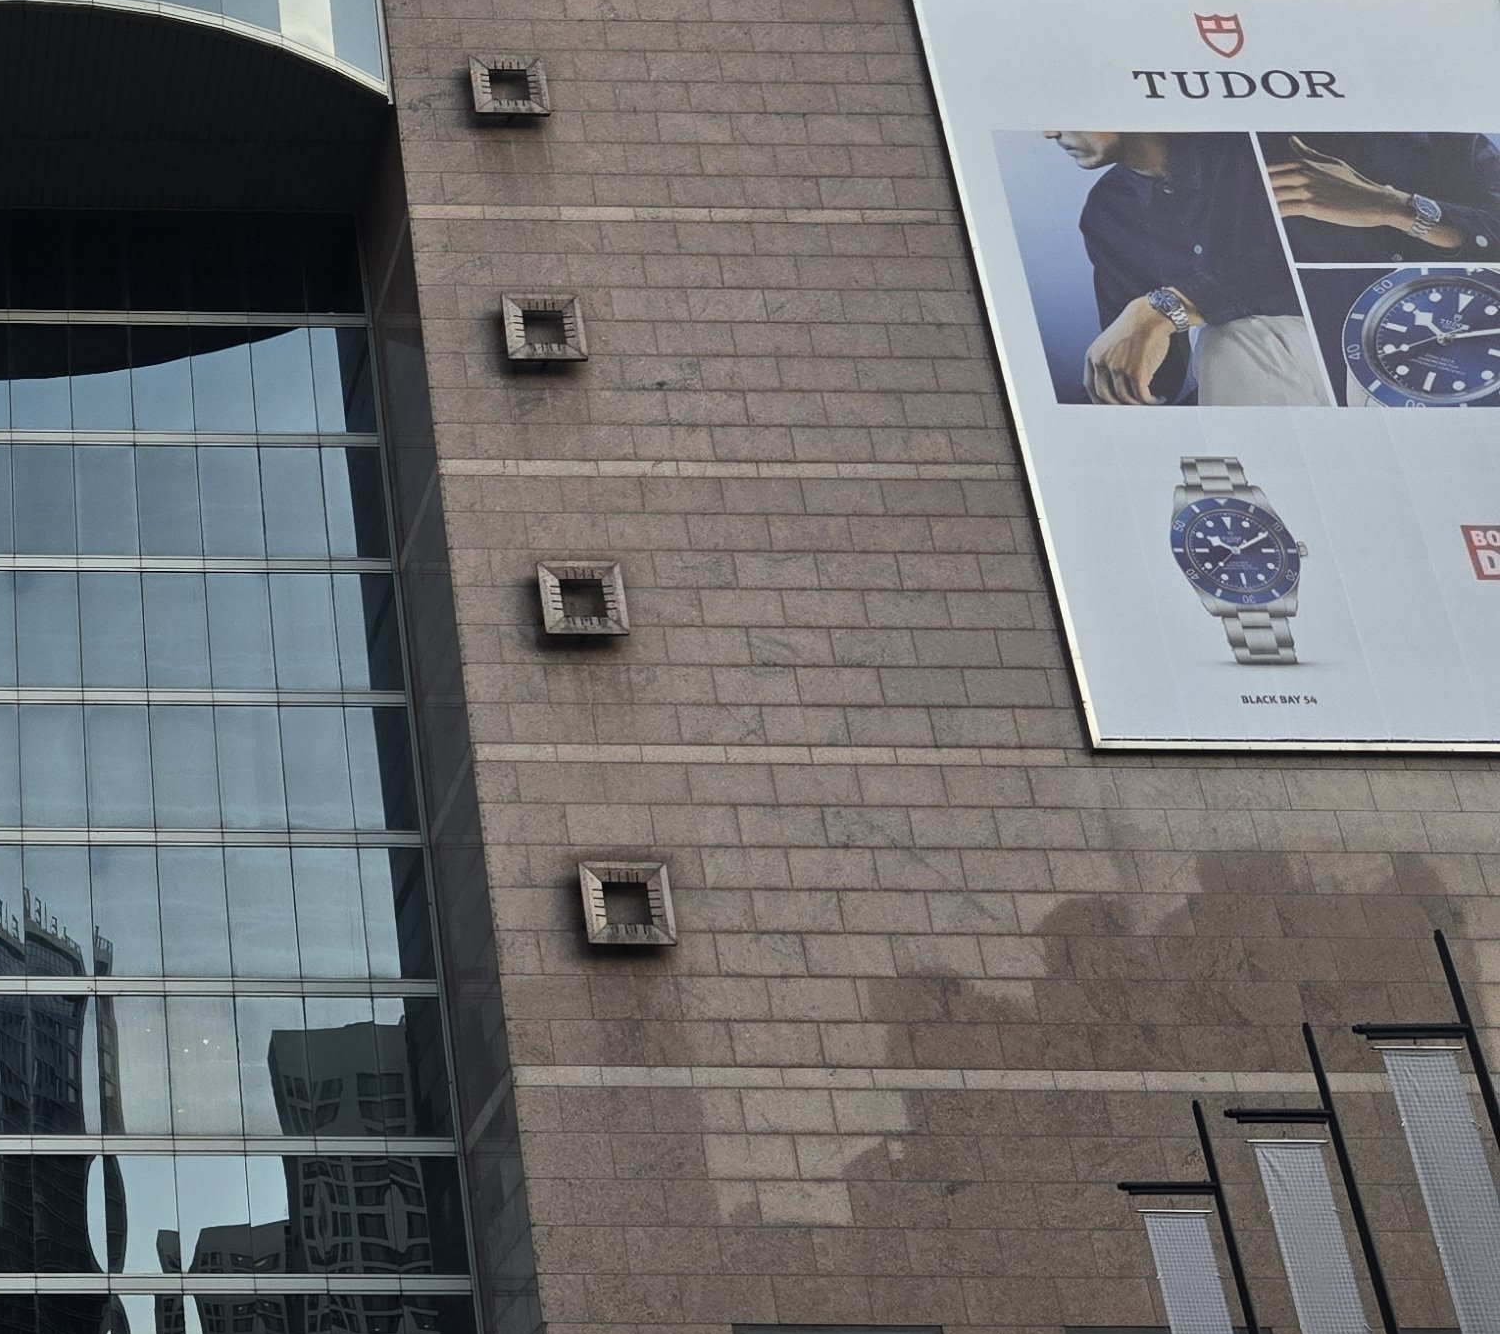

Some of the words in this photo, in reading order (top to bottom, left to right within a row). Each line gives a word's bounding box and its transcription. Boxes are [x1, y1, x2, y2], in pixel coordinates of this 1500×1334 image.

[1132, 69, 1346, 100] TUDOR
[1372, 279, 1394, 295] 50
[1347, 343, 1361, 360] 40
[1240, 695, 1278, 704] BLACK
[1279, 695, 1300, 704] BAY
[1303, 695, 1318, 704] 54
